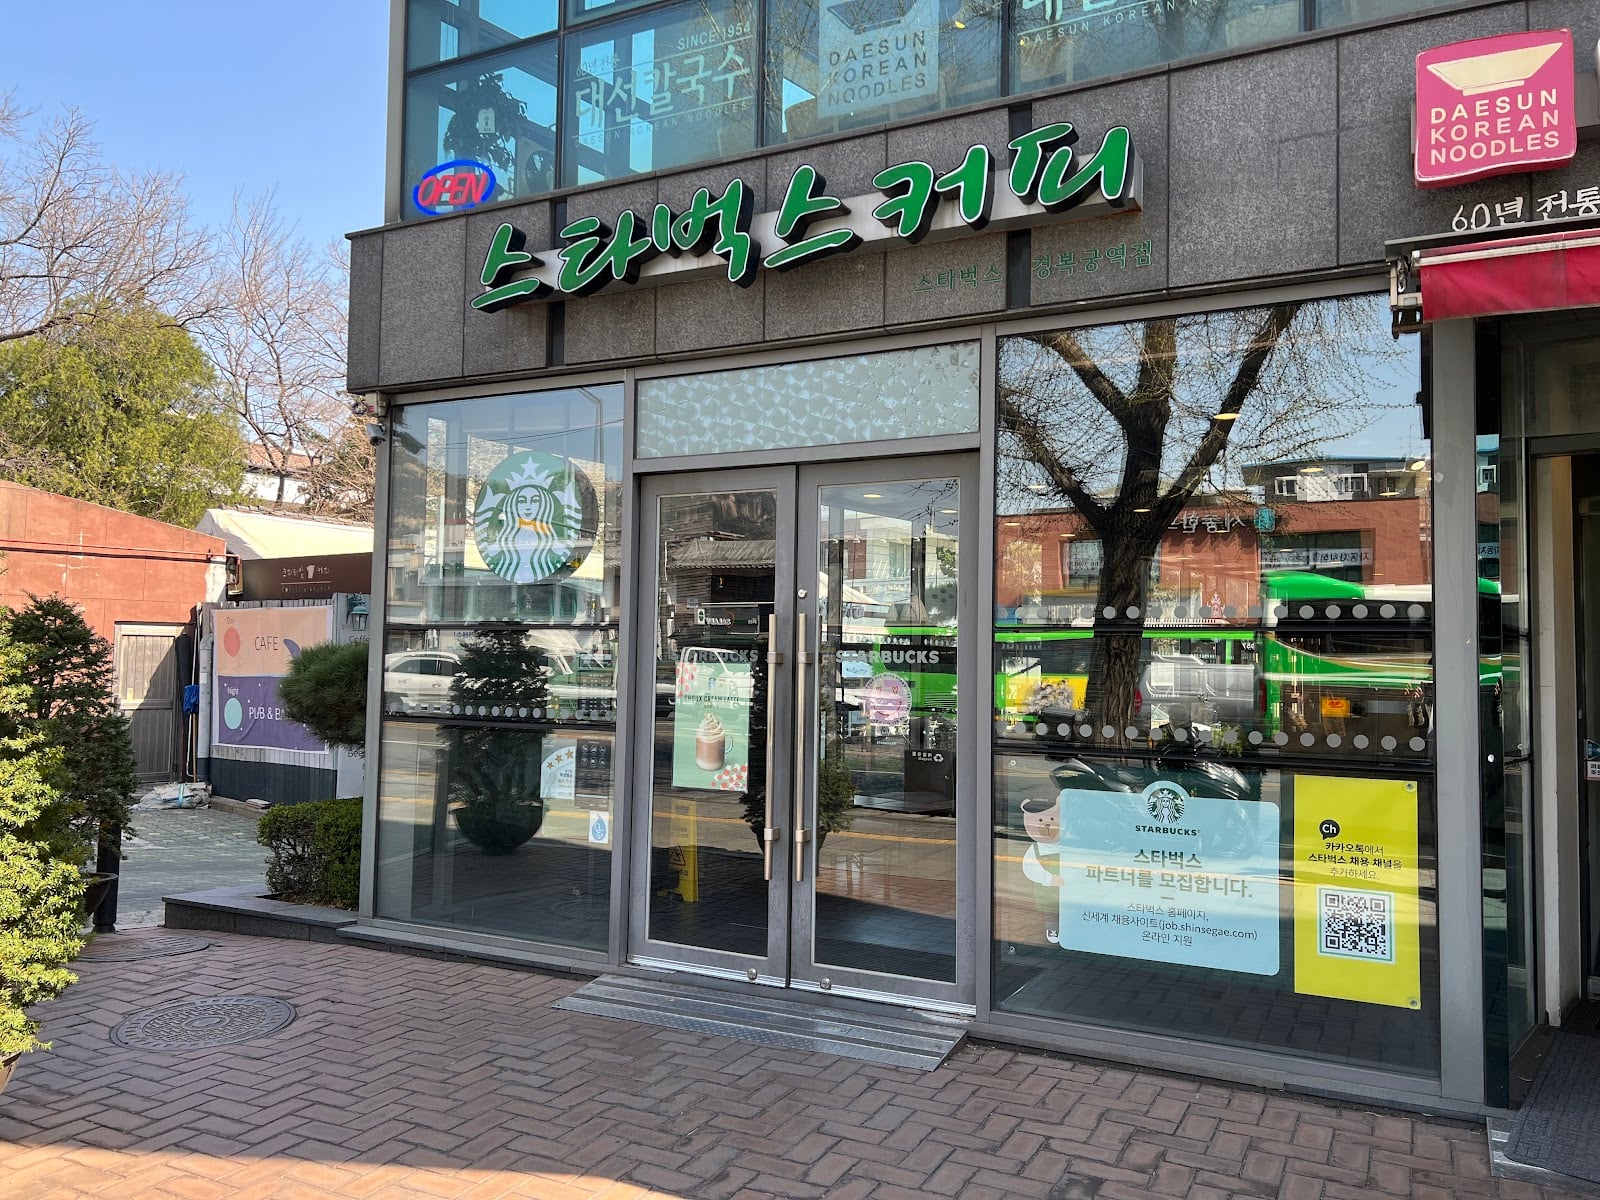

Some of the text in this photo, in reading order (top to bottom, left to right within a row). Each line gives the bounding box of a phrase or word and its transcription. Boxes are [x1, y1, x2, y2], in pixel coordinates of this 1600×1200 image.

[1103, 1, 1175, 26] KOREAN
[678, 21, 750, 50] SINCE 1954
[828, 29, 926, 67] DAESUN
[828, 50, 927, 85] KOREAN
[575, 44, 751, 128] 대선칼국수
[827, 72, 927, 107] NOODLES
[1430, 88, 1557, 124] DAESUN
[1430, 109, 1560, 145] KOREAN
[1430, 130, 1560, 166] NOODLES
[417, 170, 489, 207] OPEN
[1451, 196, 1525, 232] 60년
[914, 239, 1153, 293] 스타벅스 경복궁역점
[254, 636, 279, 651] CAFE
[671, 649, 759, 662] SARBUCKS
[836, 649, 940, 664] STARBUCKS
[248, 706, 265, 720] PUB
[267, 706, 273, 720] &
[1135, 824, 1197, 837] STARBUCKS
[1321, 823, 1337, 834] Ch
[1133, 848, 1203, 869] 스타벅스
[1307, 853, 1403, 870] 스타벅스 채용 채널을
[1325, 842, 1384, 856] 카카오톡에서
[1086, 864, 1253, 898] 파트너를 모집합니다.
[1329, 867, 1380, 881] 추가하세요.
[1081, 910, 1258, 941] 신세계 채용사이트(job.shinsegae.com)
[1127, 902, 1209, 922] 스타벅스 홈페이지,
[1141, 930, 1193, 947] 온라인 지원
